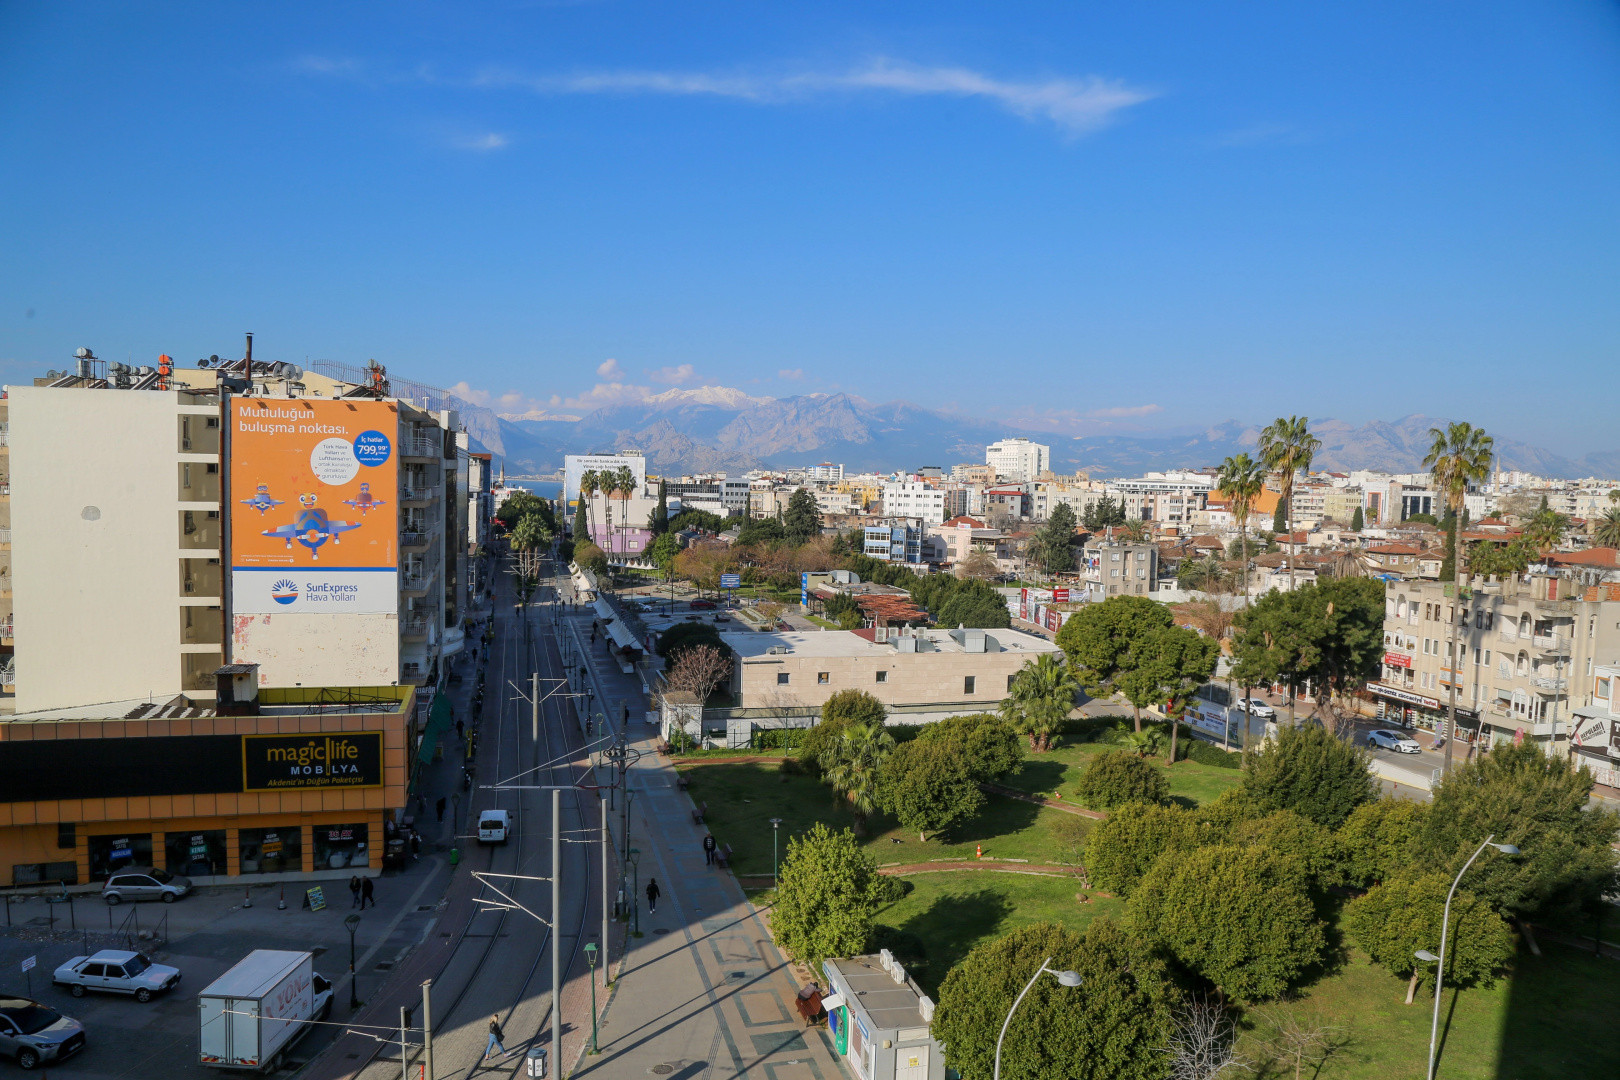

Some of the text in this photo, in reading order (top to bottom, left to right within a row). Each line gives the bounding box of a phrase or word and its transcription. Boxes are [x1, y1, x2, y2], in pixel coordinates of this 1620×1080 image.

[239, 406, 315, 421] Mutluluğun
[239, 420, 349, 435] buluşma noktası.
[306, 583, 358, 594] SunExpress
[306, 592, 356, 601] Hava Yolları
[306, 777, 330, 787] Düğün
[331, 776, 364, 785] Paketçisi
